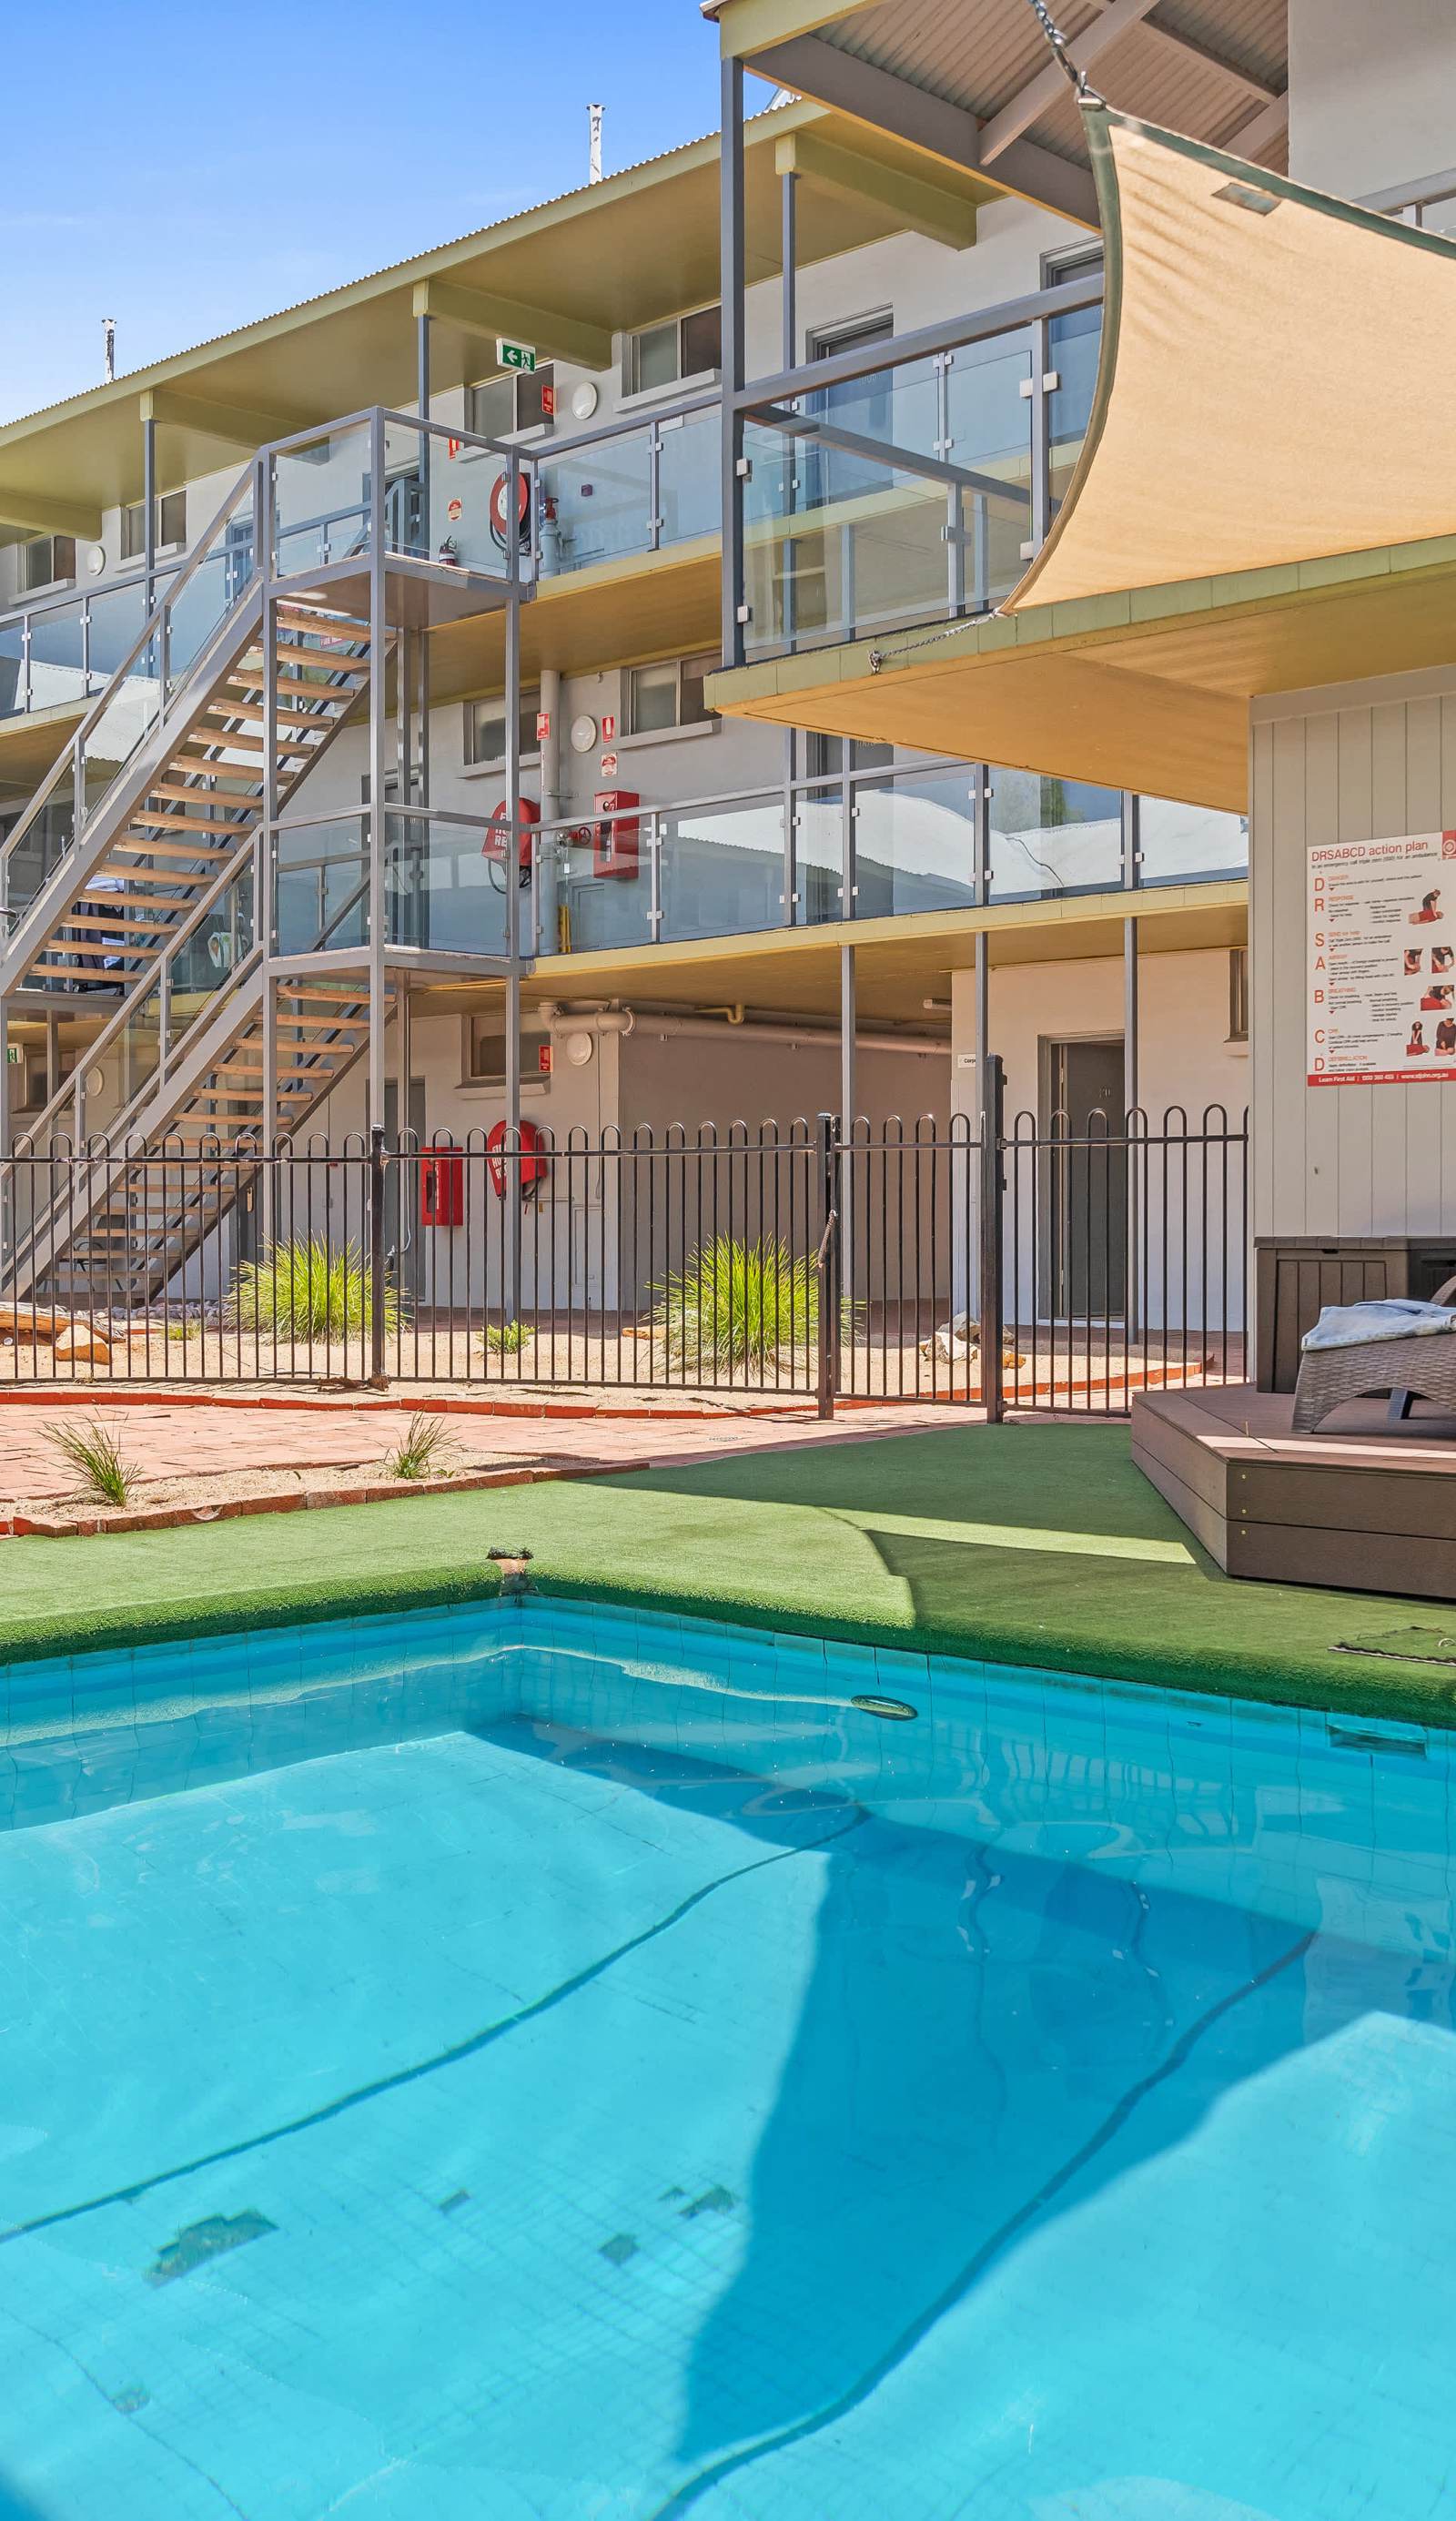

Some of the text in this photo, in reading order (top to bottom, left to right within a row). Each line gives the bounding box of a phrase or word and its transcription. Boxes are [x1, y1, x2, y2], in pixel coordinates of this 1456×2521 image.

[1311, 841, 1428, 862] DRSABCD action plan
[1314, 877, 1325, 891] D
[1314, 898, 1324, 912] R
[1315, 933, 1324, 947] S
[1315, 957, 1326, 970] A
[1314, 989, 1324, 1003] B
[1314, 1029, 1325, 1043] C
[1314, 1058, 1325, 1071] D
